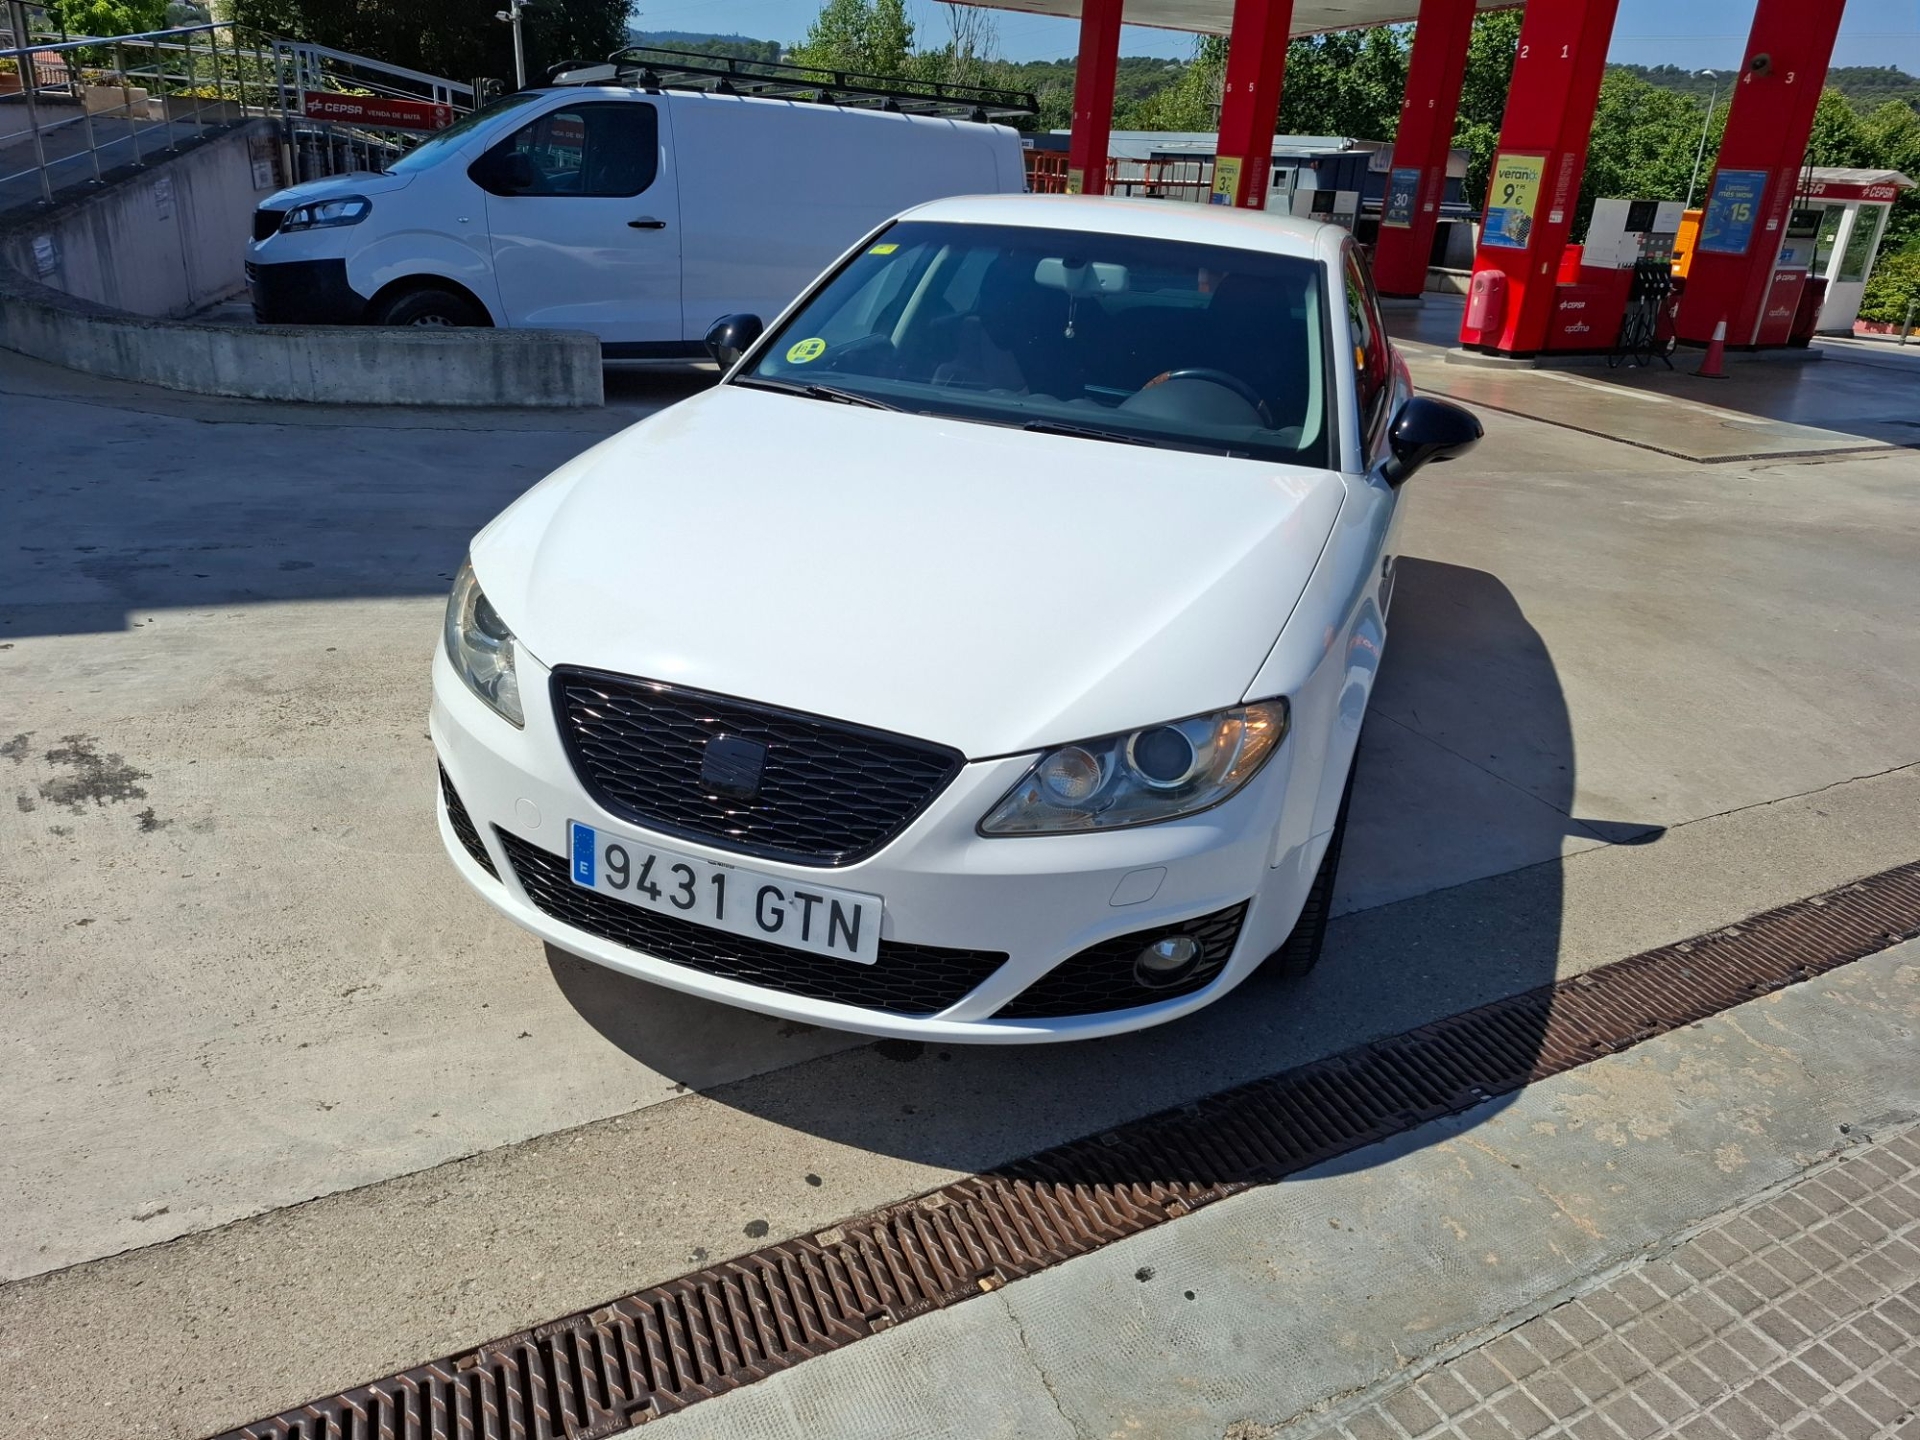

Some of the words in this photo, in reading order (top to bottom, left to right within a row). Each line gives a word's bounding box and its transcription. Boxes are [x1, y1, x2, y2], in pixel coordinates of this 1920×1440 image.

[1520, 45, 1530, 59] 2
[1560, 44, 1569, 59] 1
[1743, 72, 1752, 85] 4
[1785, 71, 1795, 84] 3
[1226, 83, 1232, 93] 6
[1248, 82, 1255, 92] 5
[324, 103, 363, 115] CEPSA
[1404, 99, 1411, 108] 6
[1428, 99, 1435, 108] 5
[367, 109, 391, 118] VENDA
[1498, 168, 1538, 182] verano
[1219, 176, 1227, 191] 3
[1502, 183, 1515, 204] 9
[1515, 195, 1523, 205] €
[1869, 186, 1895, 198] CEPSA
[1394, 193, 1408, 206] 30
[1731, 203, 1752, 221] 15
[580, 861, 588, 875] E
[604, 843, 726, 920] 9431
[755, 884, 862, 953] GTN
